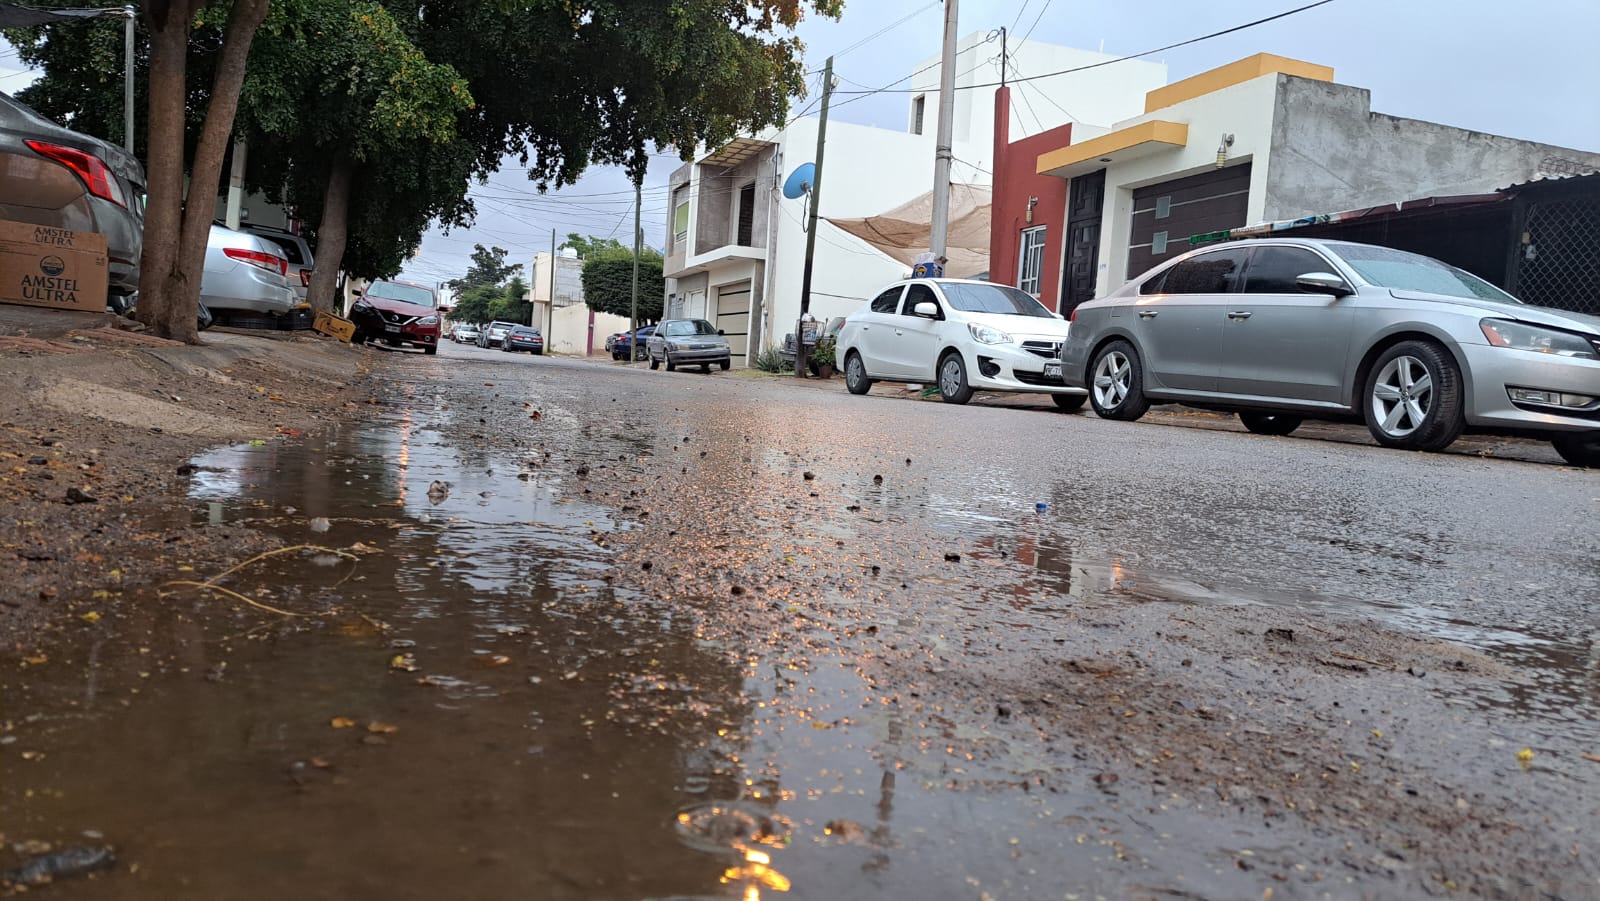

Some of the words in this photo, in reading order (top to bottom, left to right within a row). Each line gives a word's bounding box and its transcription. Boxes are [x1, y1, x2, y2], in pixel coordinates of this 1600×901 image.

[34, 227, 75, 239] AMSTEL
[35, 234, 73, 246] ULTRA
[21, 275, 80, 292] AMSTEL
[23, 287, 77, 303] ULTRA
